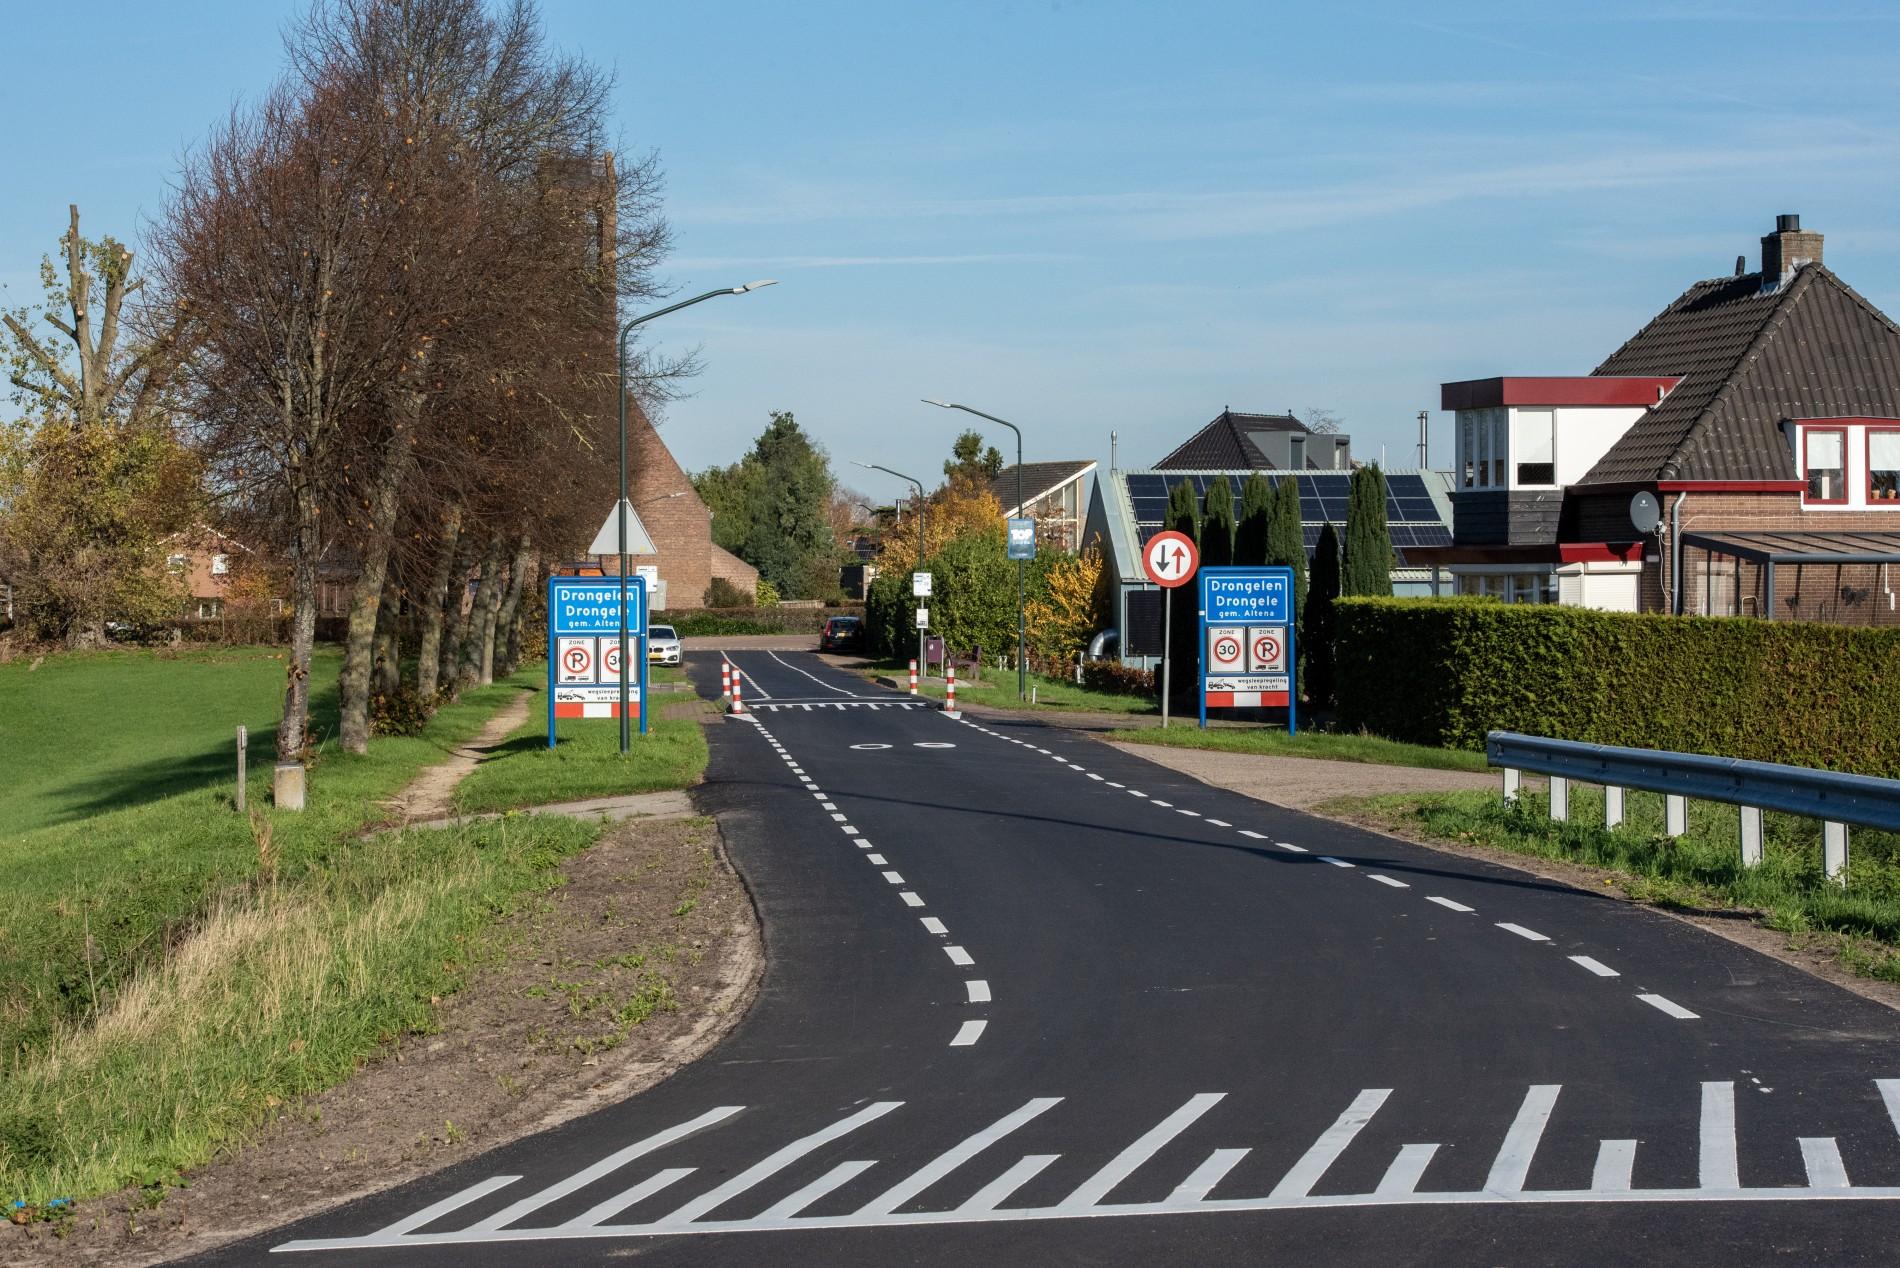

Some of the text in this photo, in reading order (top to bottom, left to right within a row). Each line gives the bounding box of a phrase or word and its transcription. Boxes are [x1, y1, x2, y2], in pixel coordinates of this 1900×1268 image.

[1211, 580, 1282, 594] Drongelen
[1216, 595, 1278, 610] Drongele
[1219, 611, 1241, 619] gem.
[568, 619, 620, 629] gem. Alten
[1218, 645, 1236, 654] 30
[609, 655, 621, 666] 3
